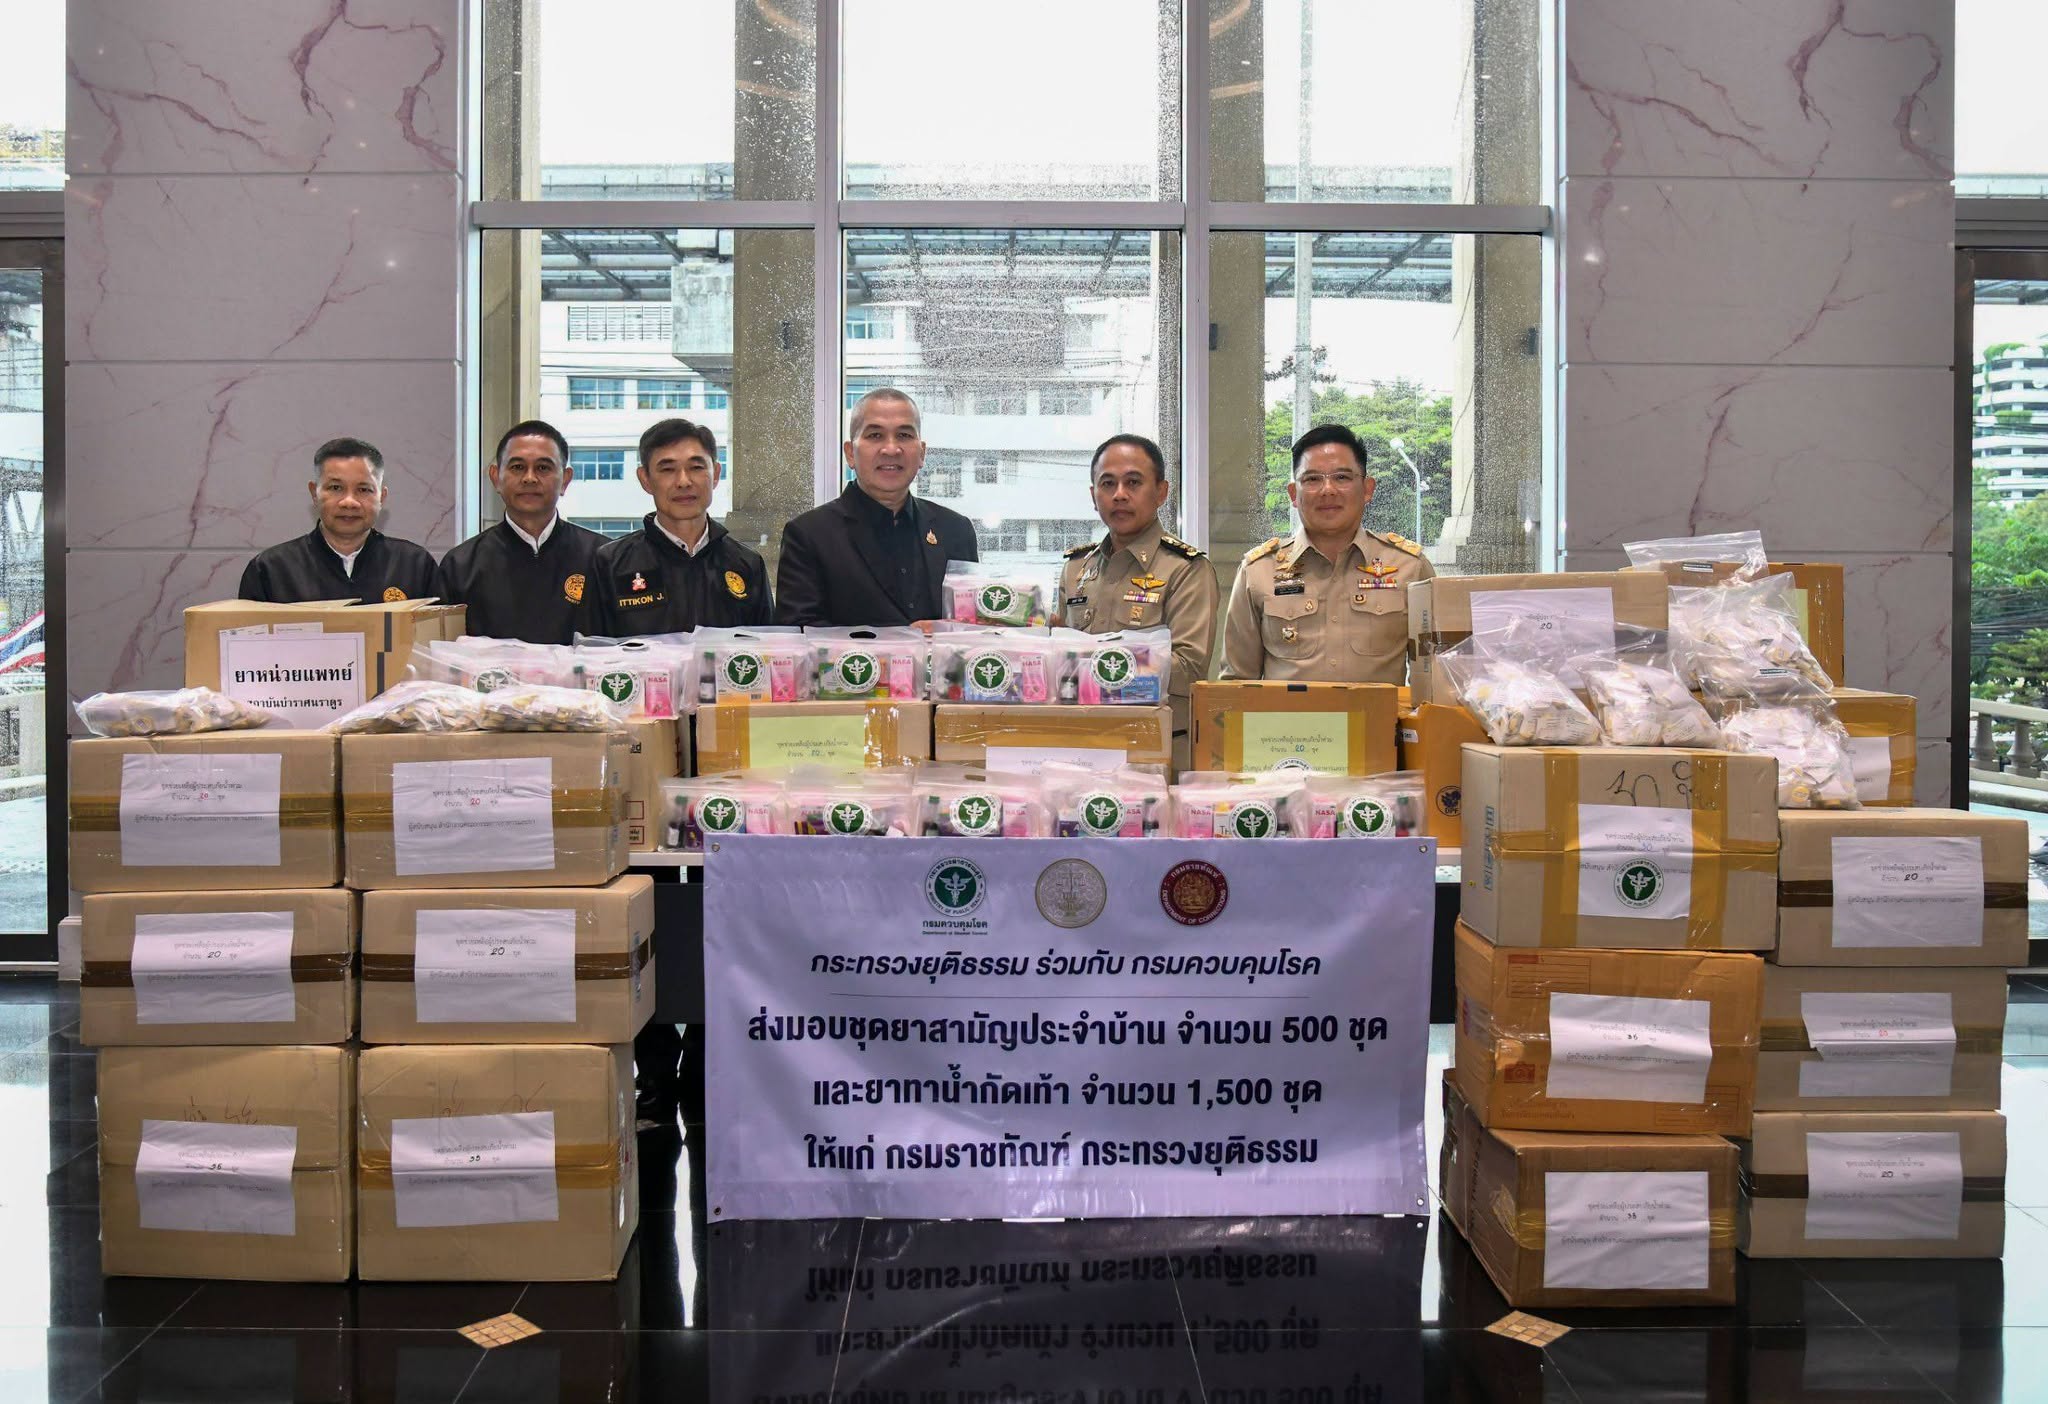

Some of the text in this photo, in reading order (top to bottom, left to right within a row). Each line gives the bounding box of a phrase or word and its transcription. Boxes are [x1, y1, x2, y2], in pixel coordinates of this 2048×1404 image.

[619, 595, 654, 607] ITTIKON
[1540, 622, 1553, 630] 20
[235, 661, 354, 683] ยาหน่วยแพทย์
[247, 696, 343, 709] ถาบันบำราศนราดูร
[1295, 744, 1305, 752] 20
[470, 797, 481, 806] 20
[1903, 873, 1919, 881] 20
[922, 917, 988, 931] กรมควบคุมโรค
[207, 950, 222, 959] 20
[490, 946, 505, 956] 20
[810, 947, 1321, 985] กระทรวงยุติธรรม ร่วมกับ กรมควบคุมโรค
[747, 1006, 1388, 1053] ส่งมอบชุดยาสามัญประจำบ้าน จำนวน 500 ชุด
[813, 1063, 1323, 1114] และยาทาน้ำกัดเท้า จำนวน 1,500 ชุด
[804, 1131, 1318, 1177] ให้แก่ กรมราชทัณฑ์ กระทรวงยุติธรรม
